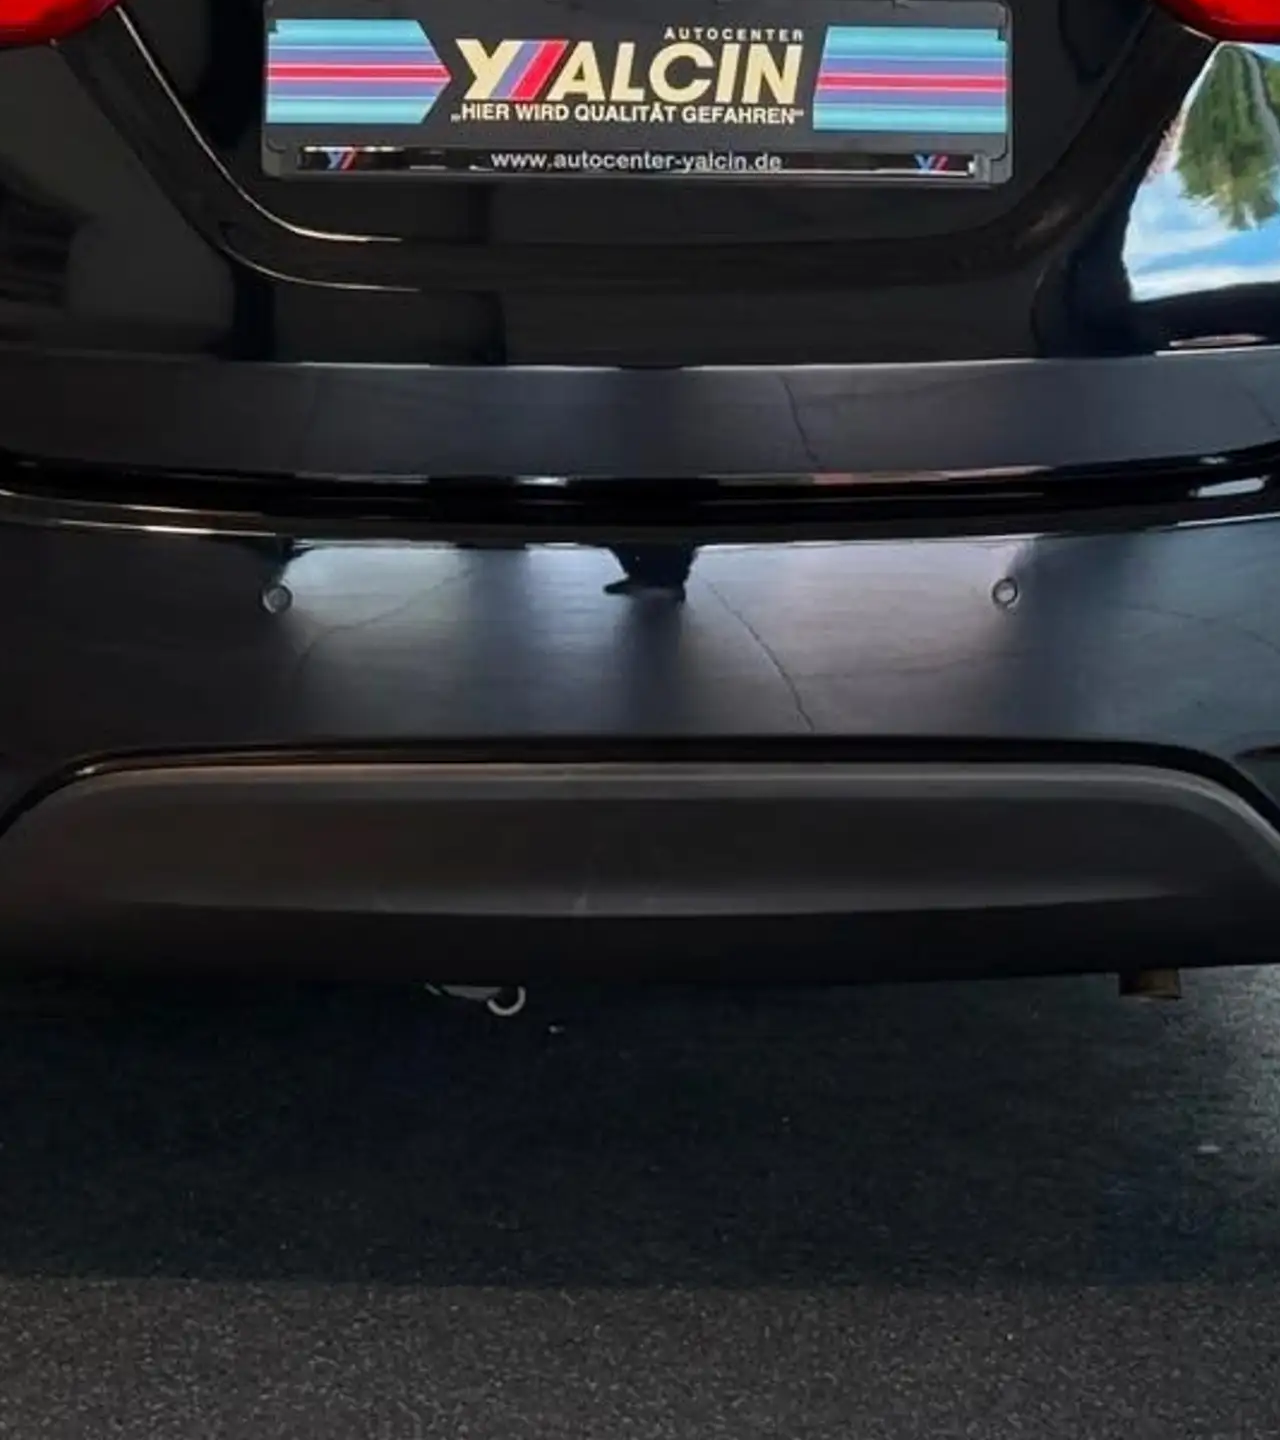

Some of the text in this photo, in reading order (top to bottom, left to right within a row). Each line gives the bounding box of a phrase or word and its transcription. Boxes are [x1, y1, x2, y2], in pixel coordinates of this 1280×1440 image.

[663, 26, 805, 42] AUTOCENTER
[514, 104, 570, 122] WIRD
[574, 102, 676, 123] QUALITÄT
[490, 150, 784, 173] www.autocenter-yalcin.de
